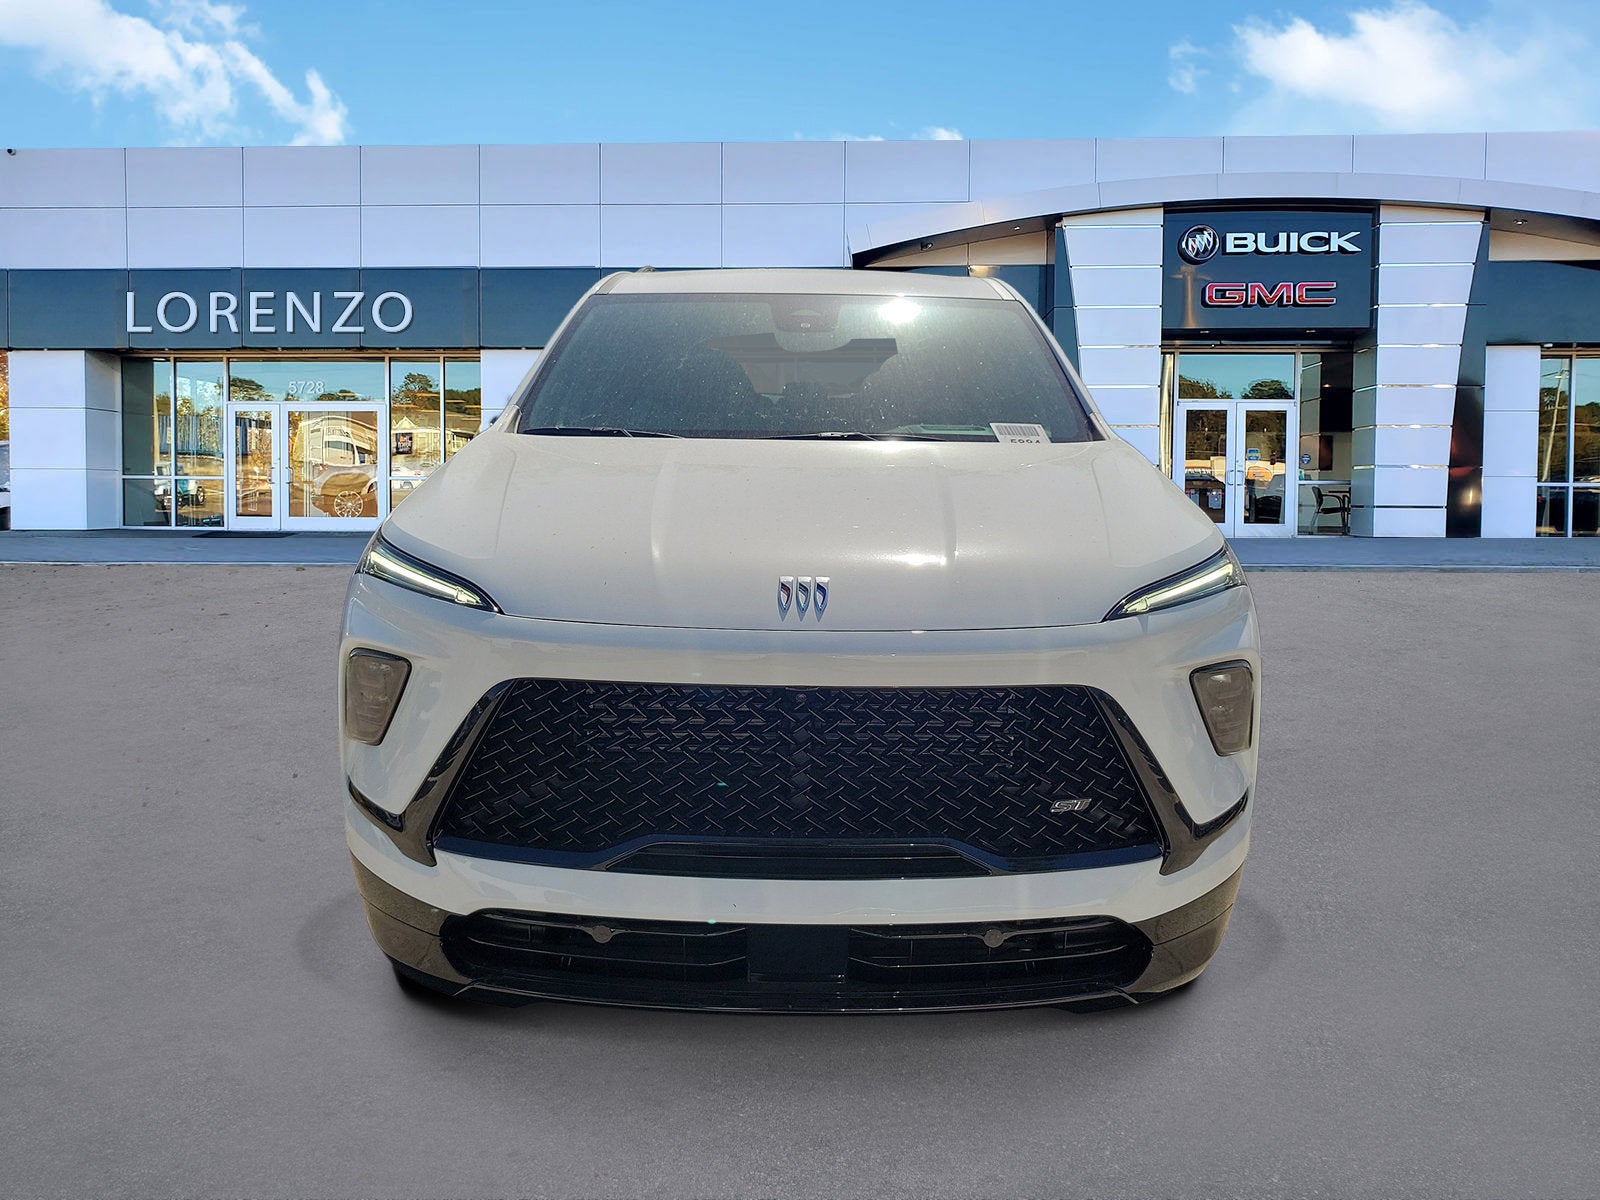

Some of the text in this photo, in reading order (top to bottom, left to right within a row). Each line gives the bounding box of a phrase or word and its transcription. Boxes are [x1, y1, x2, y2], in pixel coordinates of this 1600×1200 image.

[1224, 231, 1362, 254] BUICK
[1205, 281, 1337, 305] GMC
[125, 291, 413, 333] LORENZO
[288, 381, 325, 394] 5728
[1050, 798, 1092, 813] ST
